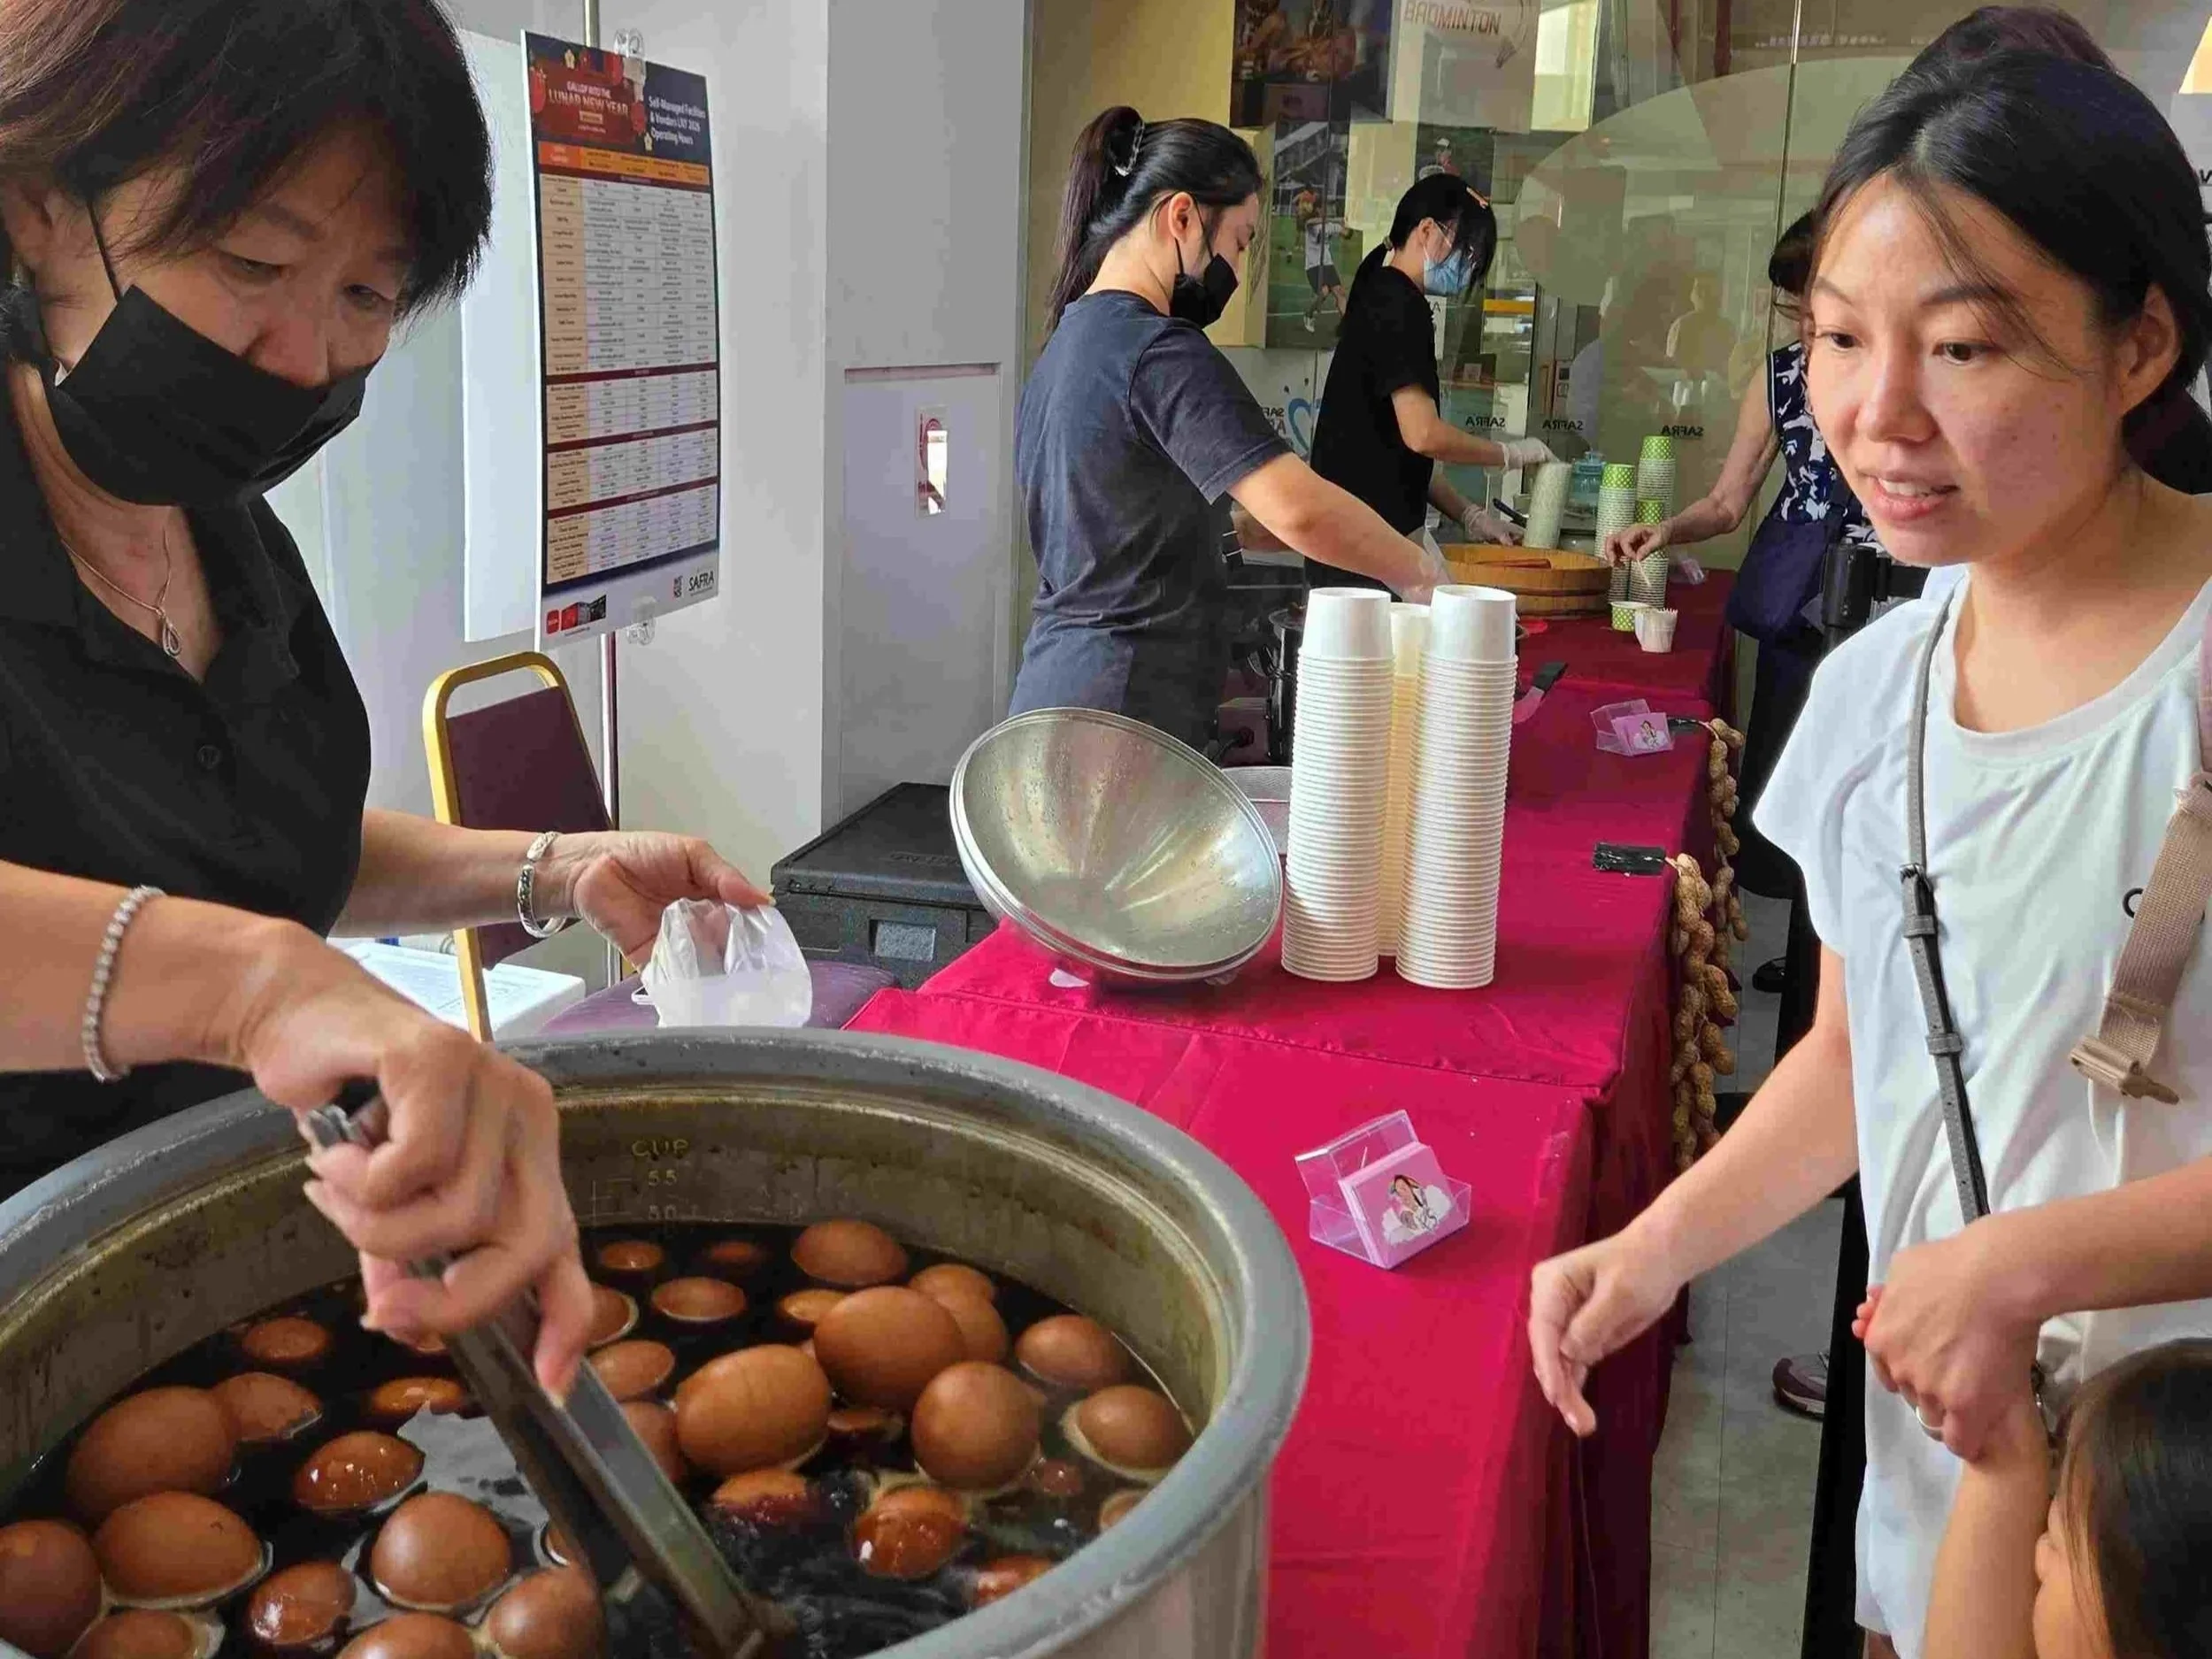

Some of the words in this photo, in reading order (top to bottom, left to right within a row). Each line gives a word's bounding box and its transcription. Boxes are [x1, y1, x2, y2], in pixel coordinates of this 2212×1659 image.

[1404, 0, 1502, 35] BADMINTON
[549, 88, 581, 106] LUNAR
[582, 95, 604, 111] NEW
[604, 99, 629, 118] YEAR
[688, 570, 715, 591] SAFRA
